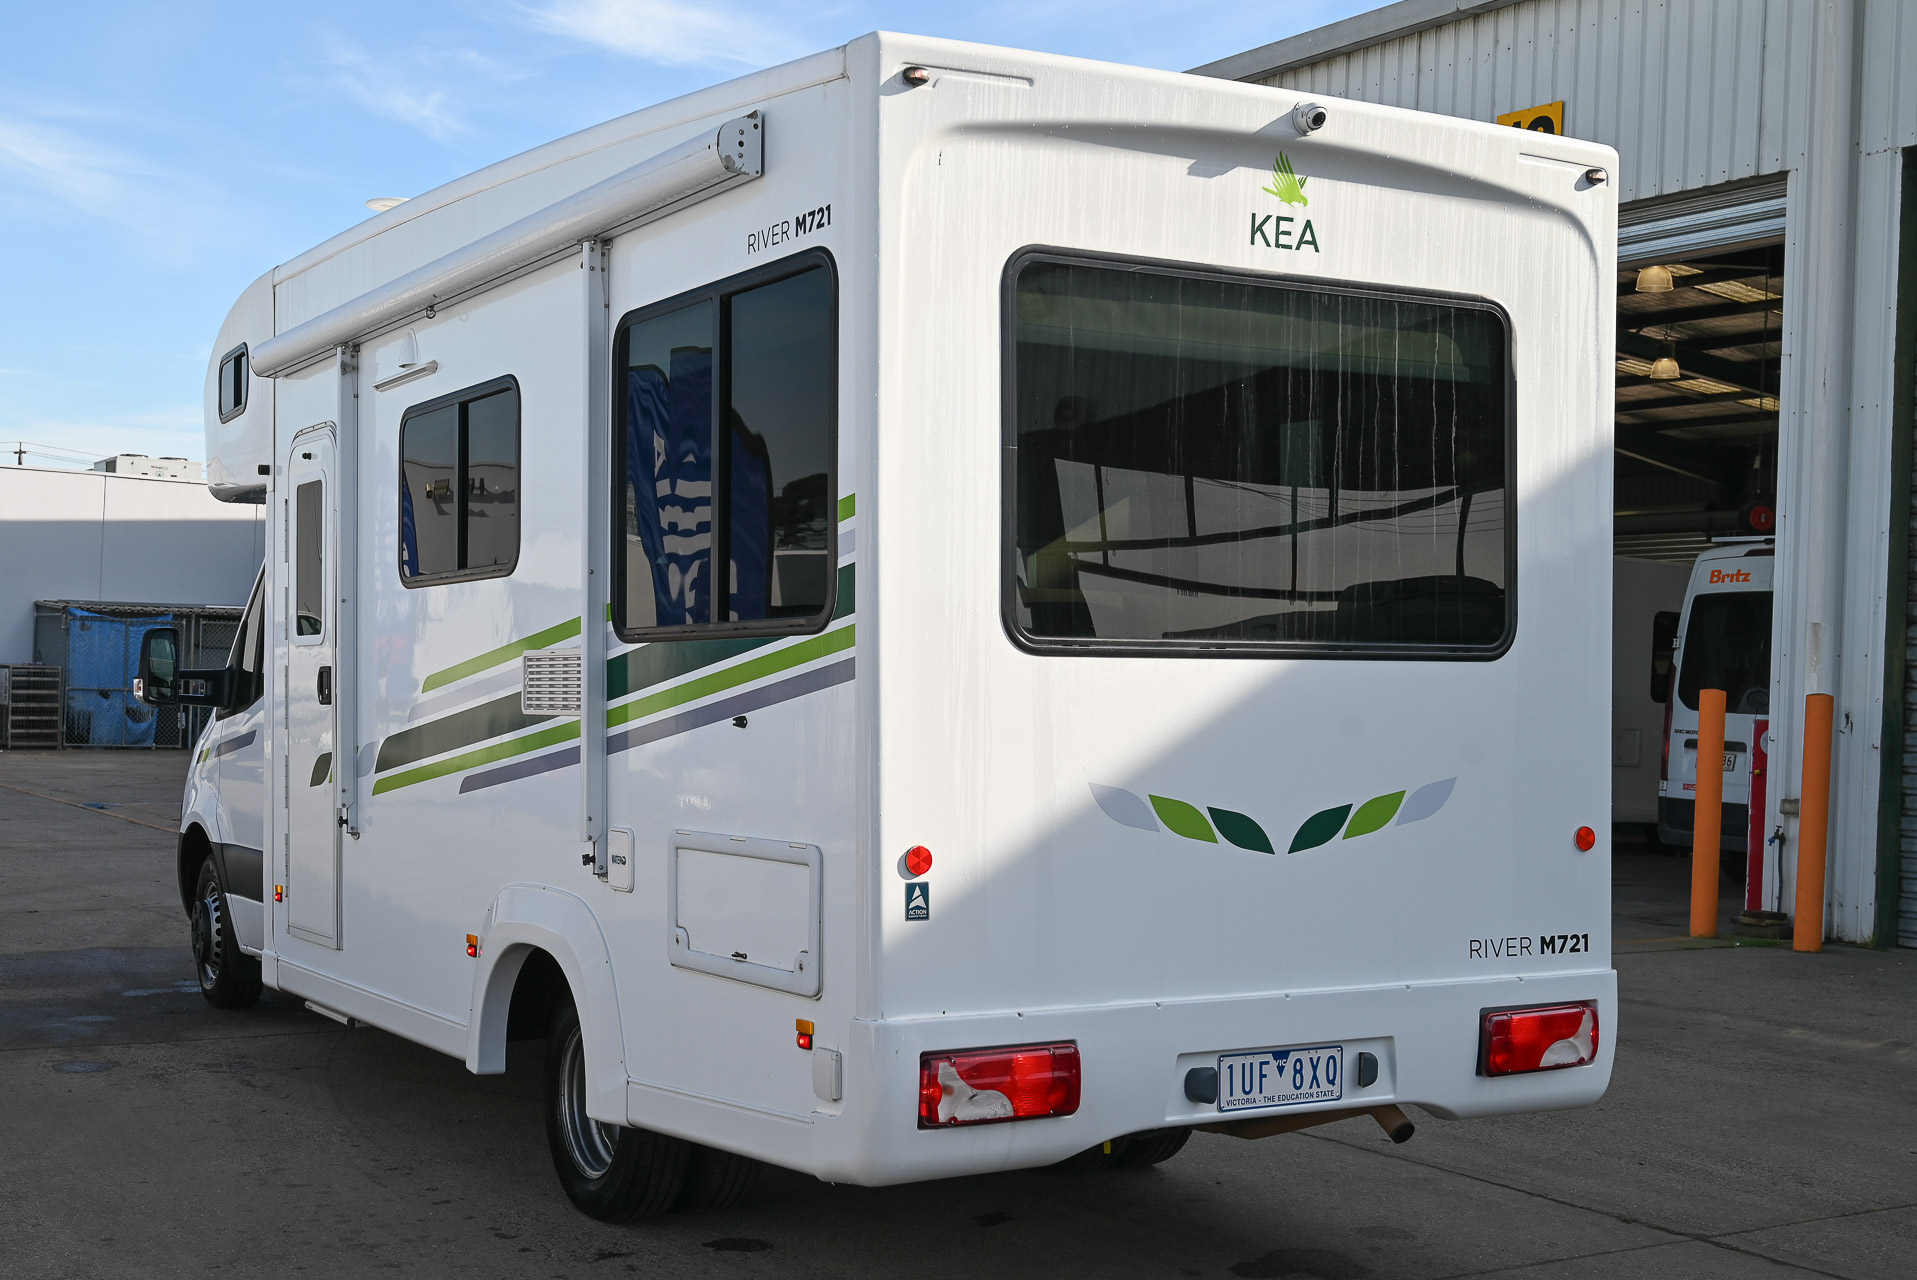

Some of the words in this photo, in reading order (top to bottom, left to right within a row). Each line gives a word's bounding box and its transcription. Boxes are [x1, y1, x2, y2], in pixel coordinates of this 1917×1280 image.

[747, 220, 790, 255] RIVER
[795, 203, 831, 238] M721
[1250, 212, 1320, 253] KEA
[1709, 569, 1752, 584] Britz
[1469, 936, 1532, 959] RIVER
[1540, 933, 1589, 955] M721
[1227, 1060, 1270, 1097] 1UF
[1292, 1054, 1338, 1091] 8XQ
[1226, 1098, 1257, 1107] VICTORIA
[1263, 1095, 1276, 1104] THE
[1278, 1092, 1314, 1102] EDUCATION
[1315, 1089, 1335, 1098] STATE
